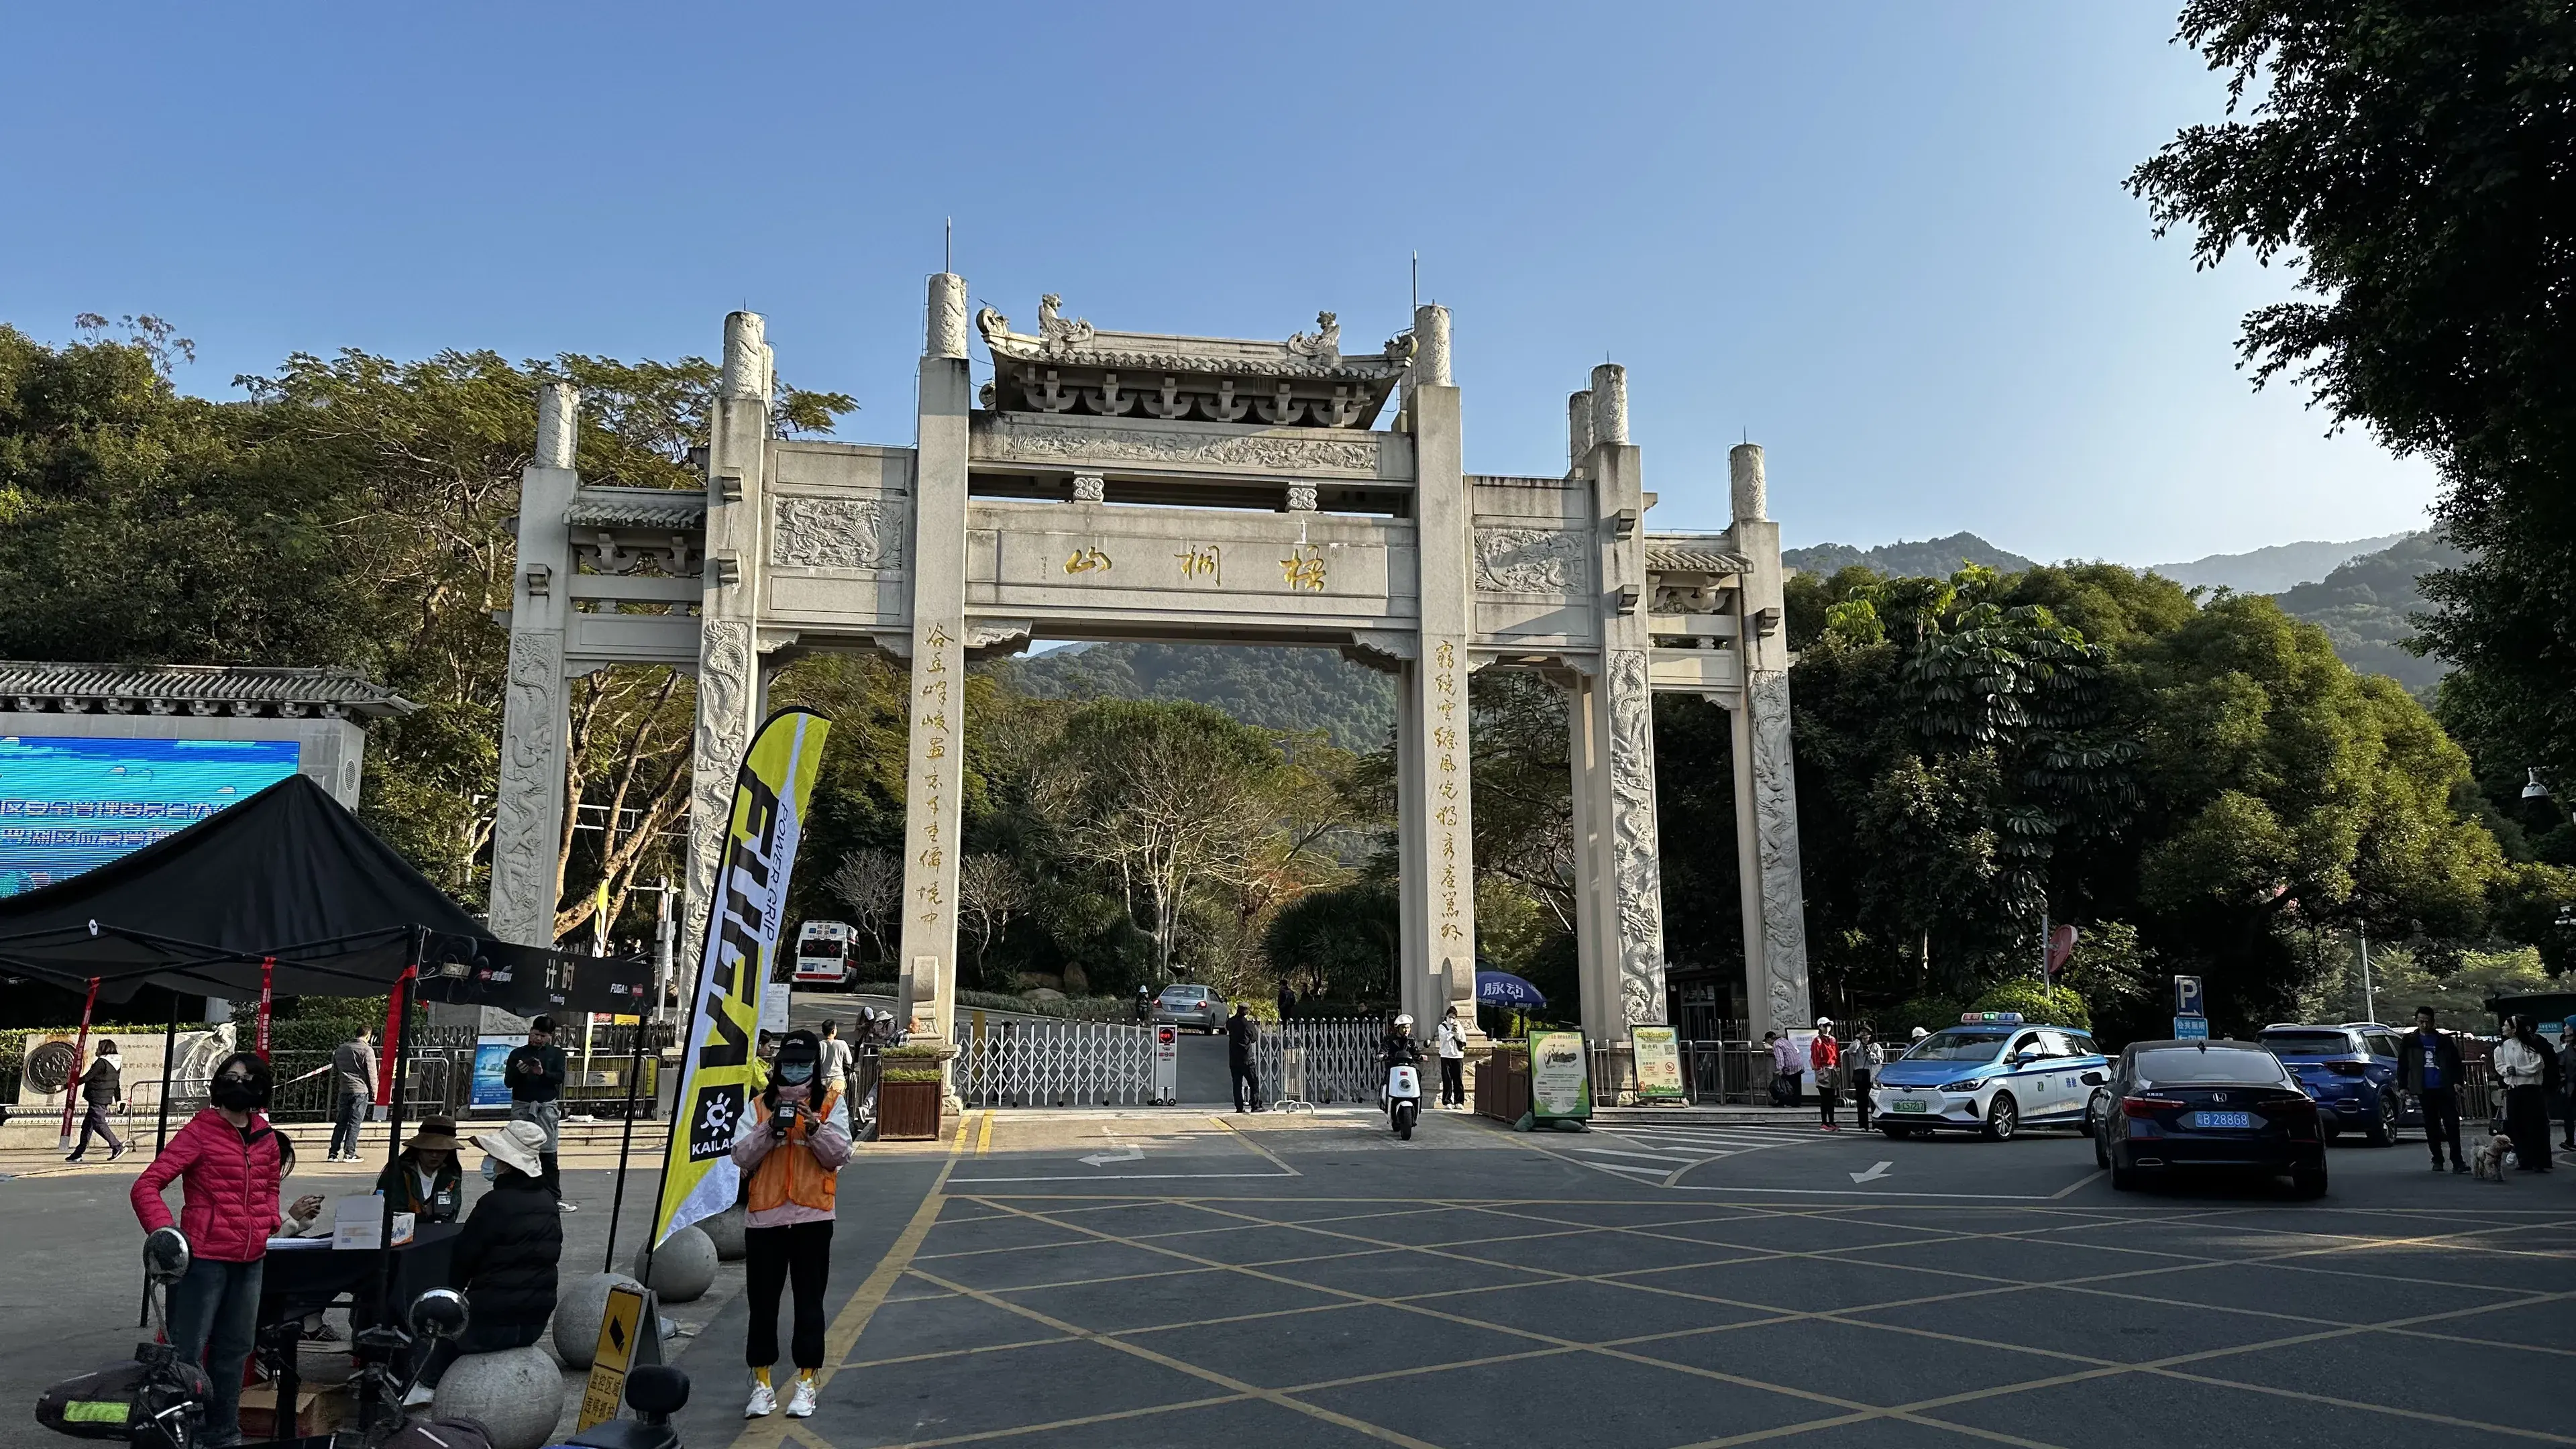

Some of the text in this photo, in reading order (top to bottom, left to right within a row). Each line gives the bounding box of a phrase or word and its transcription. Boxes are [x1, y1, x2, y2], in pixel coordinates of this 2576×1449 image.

[1, 827, 176, 847] 罗湖区应急管理
[763, 802, 789, 941] POWER GRIP
[700, 765, 780, 1069] FUGA
[545, 958, 575, 991] 计时
[1483, 981, 1524, 1000] 脉动
[2179, 979, 2198, 1008] P
[2177, 1021, 2205, 1030] 公共厕所
[2214, 1114, 2247, 1125] 288G8
